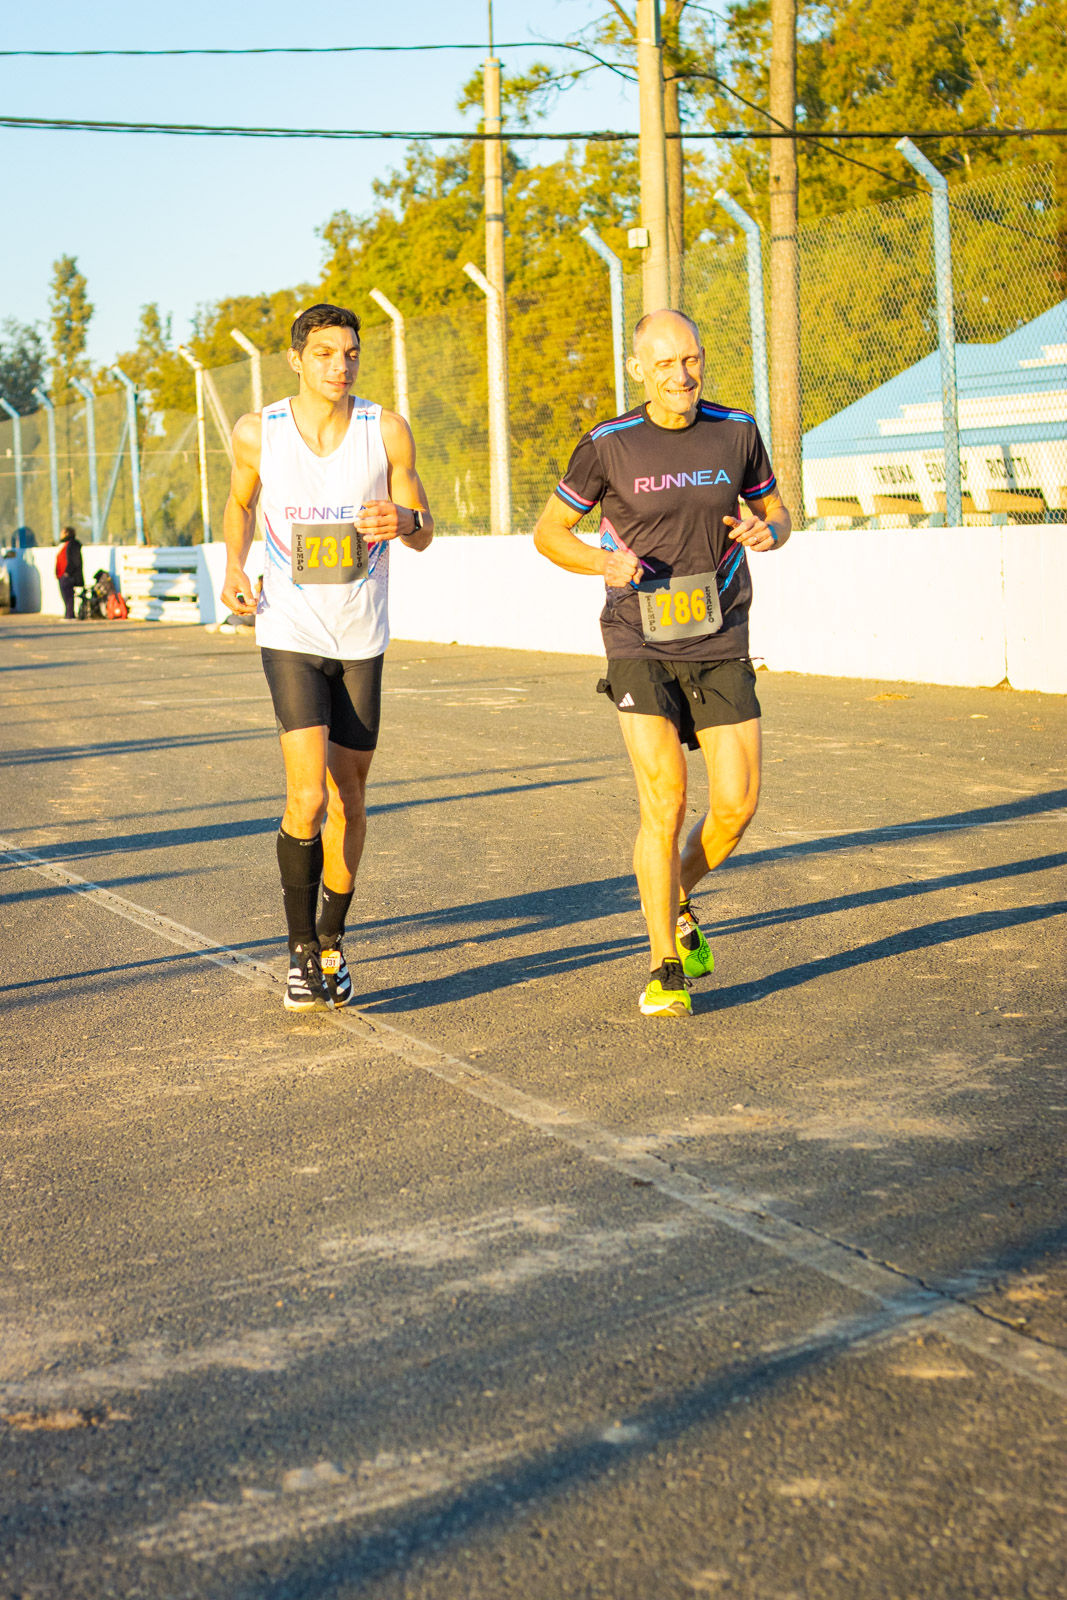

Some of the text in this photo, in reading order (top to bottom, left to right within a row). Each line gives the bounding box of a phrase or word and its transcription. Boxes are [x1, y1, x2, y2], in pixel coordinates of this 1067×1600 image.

[633, 468, 732, 494] RUNNEA
[296, 534, 304, 571] TIEMPO
[305, 535, 354, 568] 731
[645, 595, 656, 632] TIEMPO
[655, 588, 707, 627] 786
[704, 586, 715, 623] EXACTO
